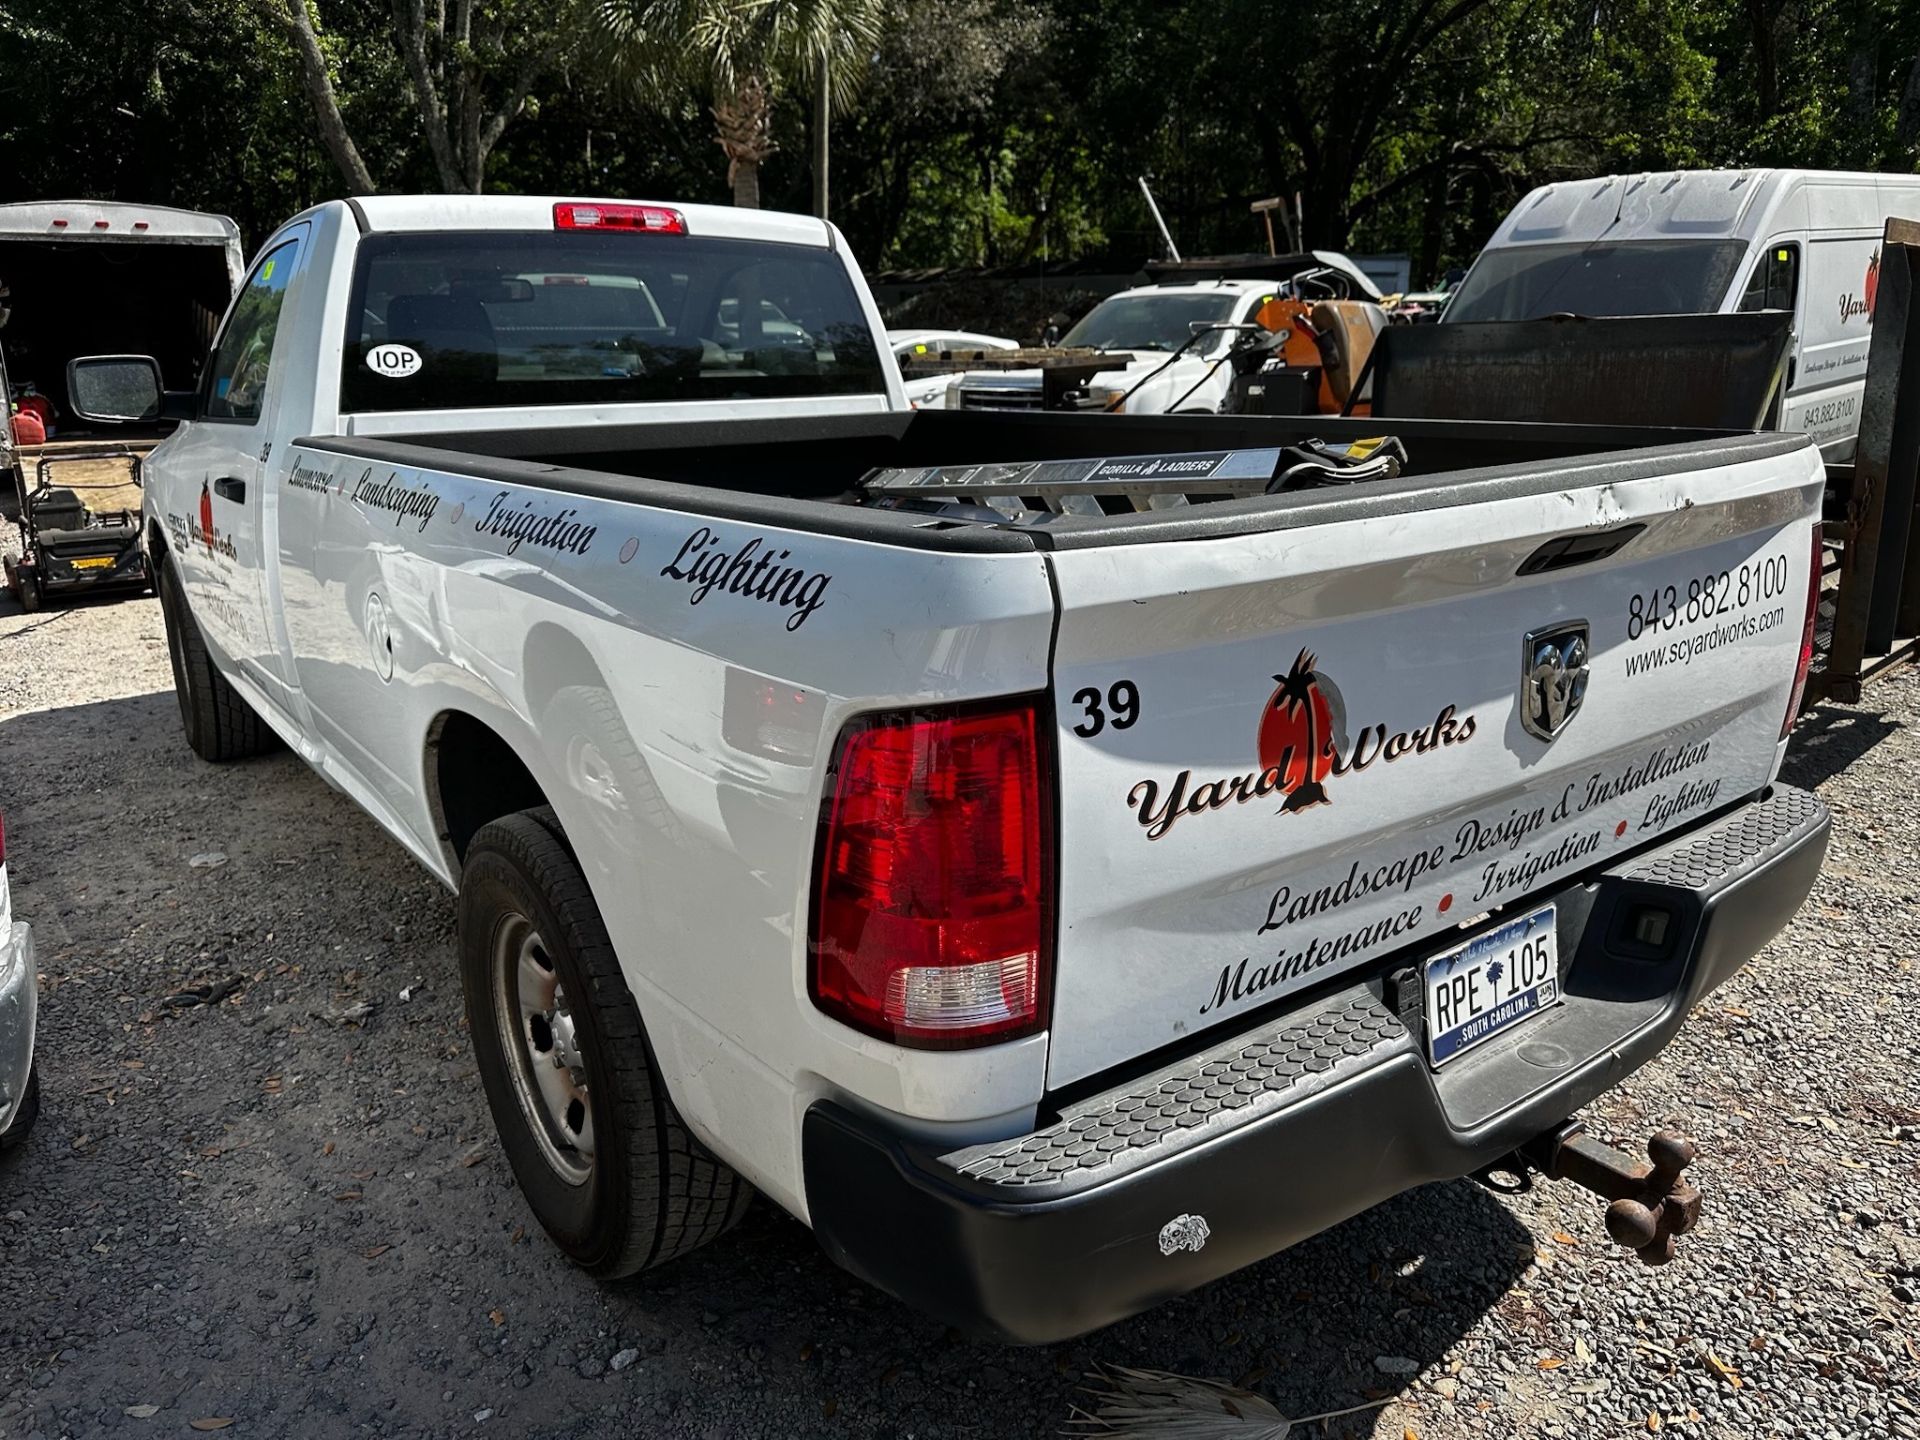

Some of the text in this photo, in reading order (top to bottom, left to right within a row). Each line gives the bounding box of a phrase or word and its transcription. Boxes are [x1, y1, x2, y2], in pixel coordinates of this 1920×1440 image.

[376, 351, 414, 369] IOP
[1804, 397, 1855, 428] 843.882.8100
[260, 442, 272, 463] 39
[1098, 460, 1216, 475] GORILLA LADDERS
[288, 454, 833, 632] Lawncare Landscaping Irrigation Lighting
[1628, 554, 1788, 641] 843.882.8100
[1625, 607, 1784, 677] www.scyardworks.com
[1071, 679, 1141, 739] 39
[1126, 704, 1478, 841] Yard Works
[1257, 740, 1711, 936] Landscape Design & Installation
[1199, 904, 1423, 1015] Maintenance
[1473, 830, 1601, 902] Irrigation
[1637, 778, 1721, 832] Lighting
[1436, 965, 1483, 1033] RPE
[1507, 935, 1548, 996] 105
[1462, 995, 1530, 1042] SOUTH CAROLINA
